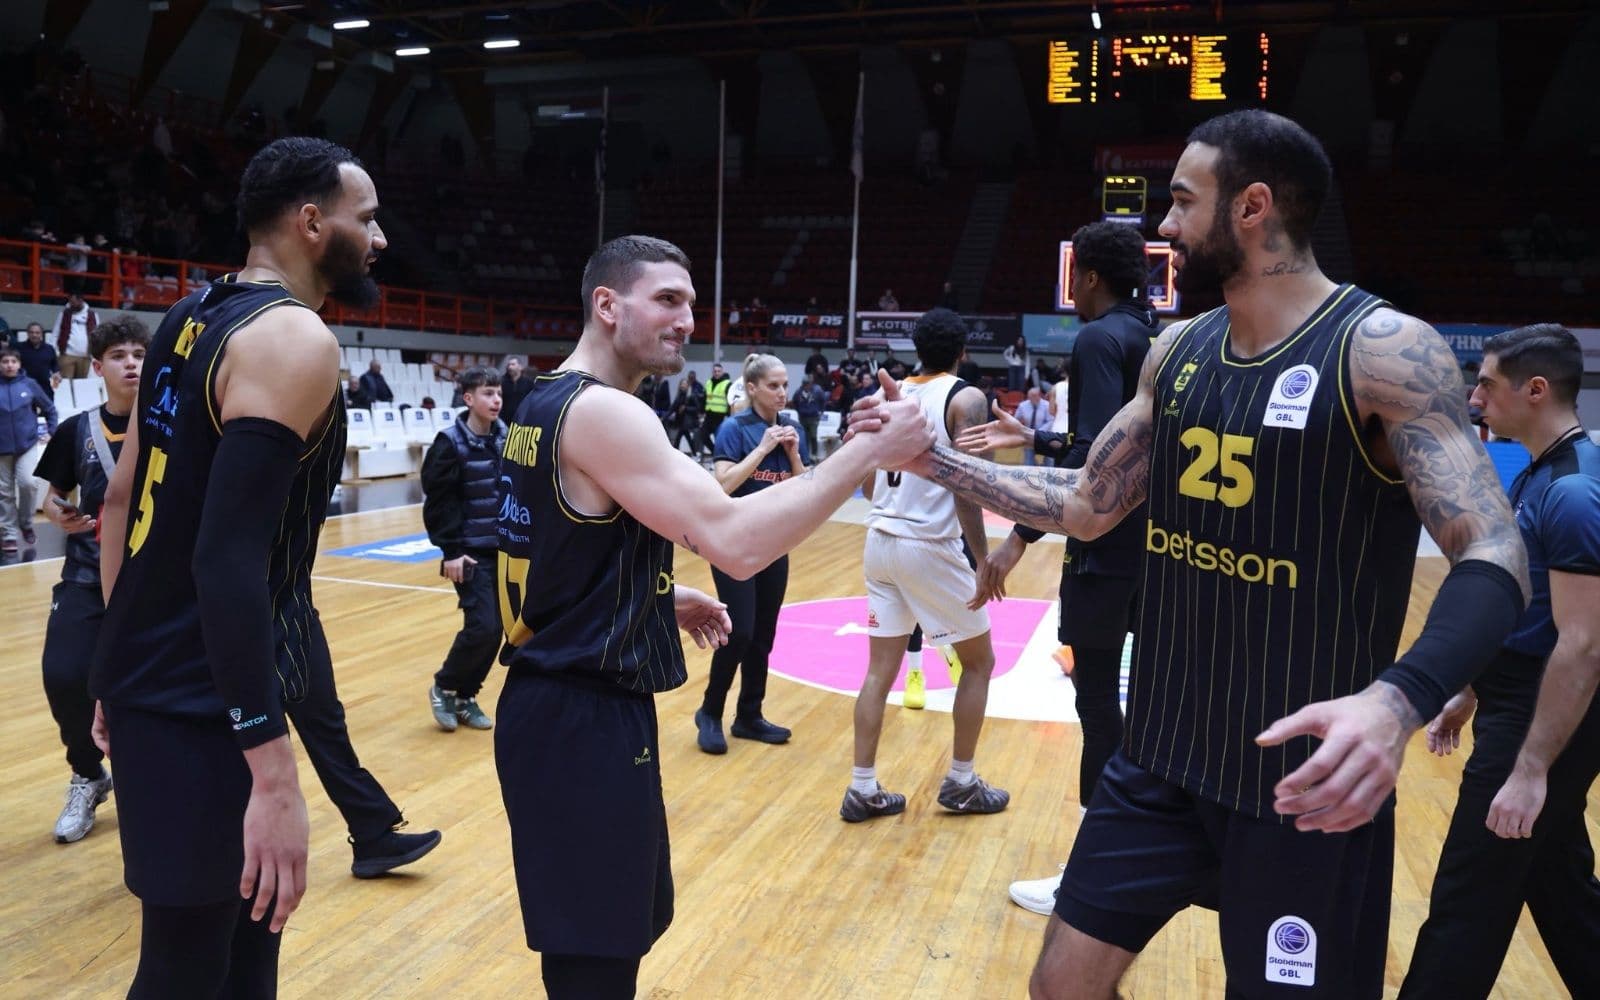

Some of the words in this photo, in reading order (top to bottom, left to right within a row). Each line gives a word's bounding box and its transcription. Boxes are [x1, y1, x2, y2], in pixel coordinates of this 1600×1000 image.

[1275, 413, 1294, 422] GBL
[1179, 427, 1254, 508] 25
[1146, 519, 1297, 589] betsson
[1279, 968, 1302, 978] GBL
